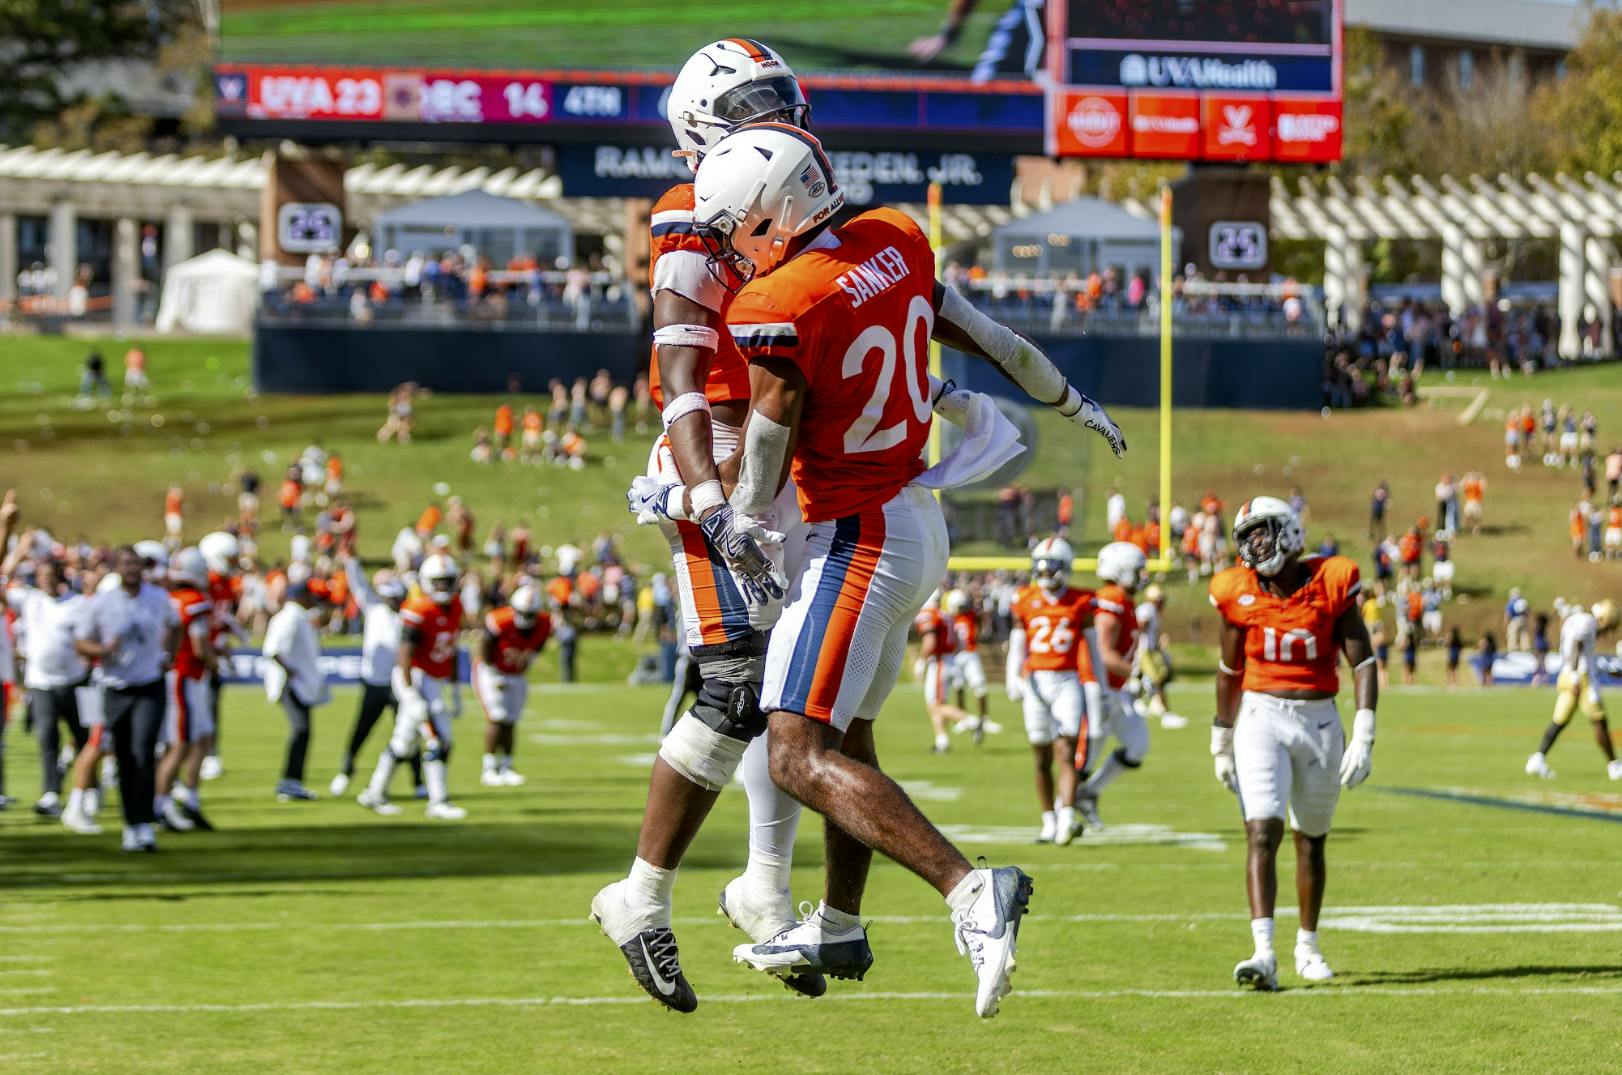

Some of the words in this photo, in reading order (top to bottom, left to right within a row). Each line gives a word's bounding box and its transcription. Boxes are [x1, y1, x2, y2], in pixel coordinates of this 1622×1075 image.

[260, 75, 334, 113] UVA
[335, 78, 381, 115] 23
[564, 86, 621, 116] 4TH
[813, 207, 831, 223] FOR
[835, 246, 911, 308] SANKER
[841, 295, 935, 454] 20
[1029, 615, 1074, 653] 26
